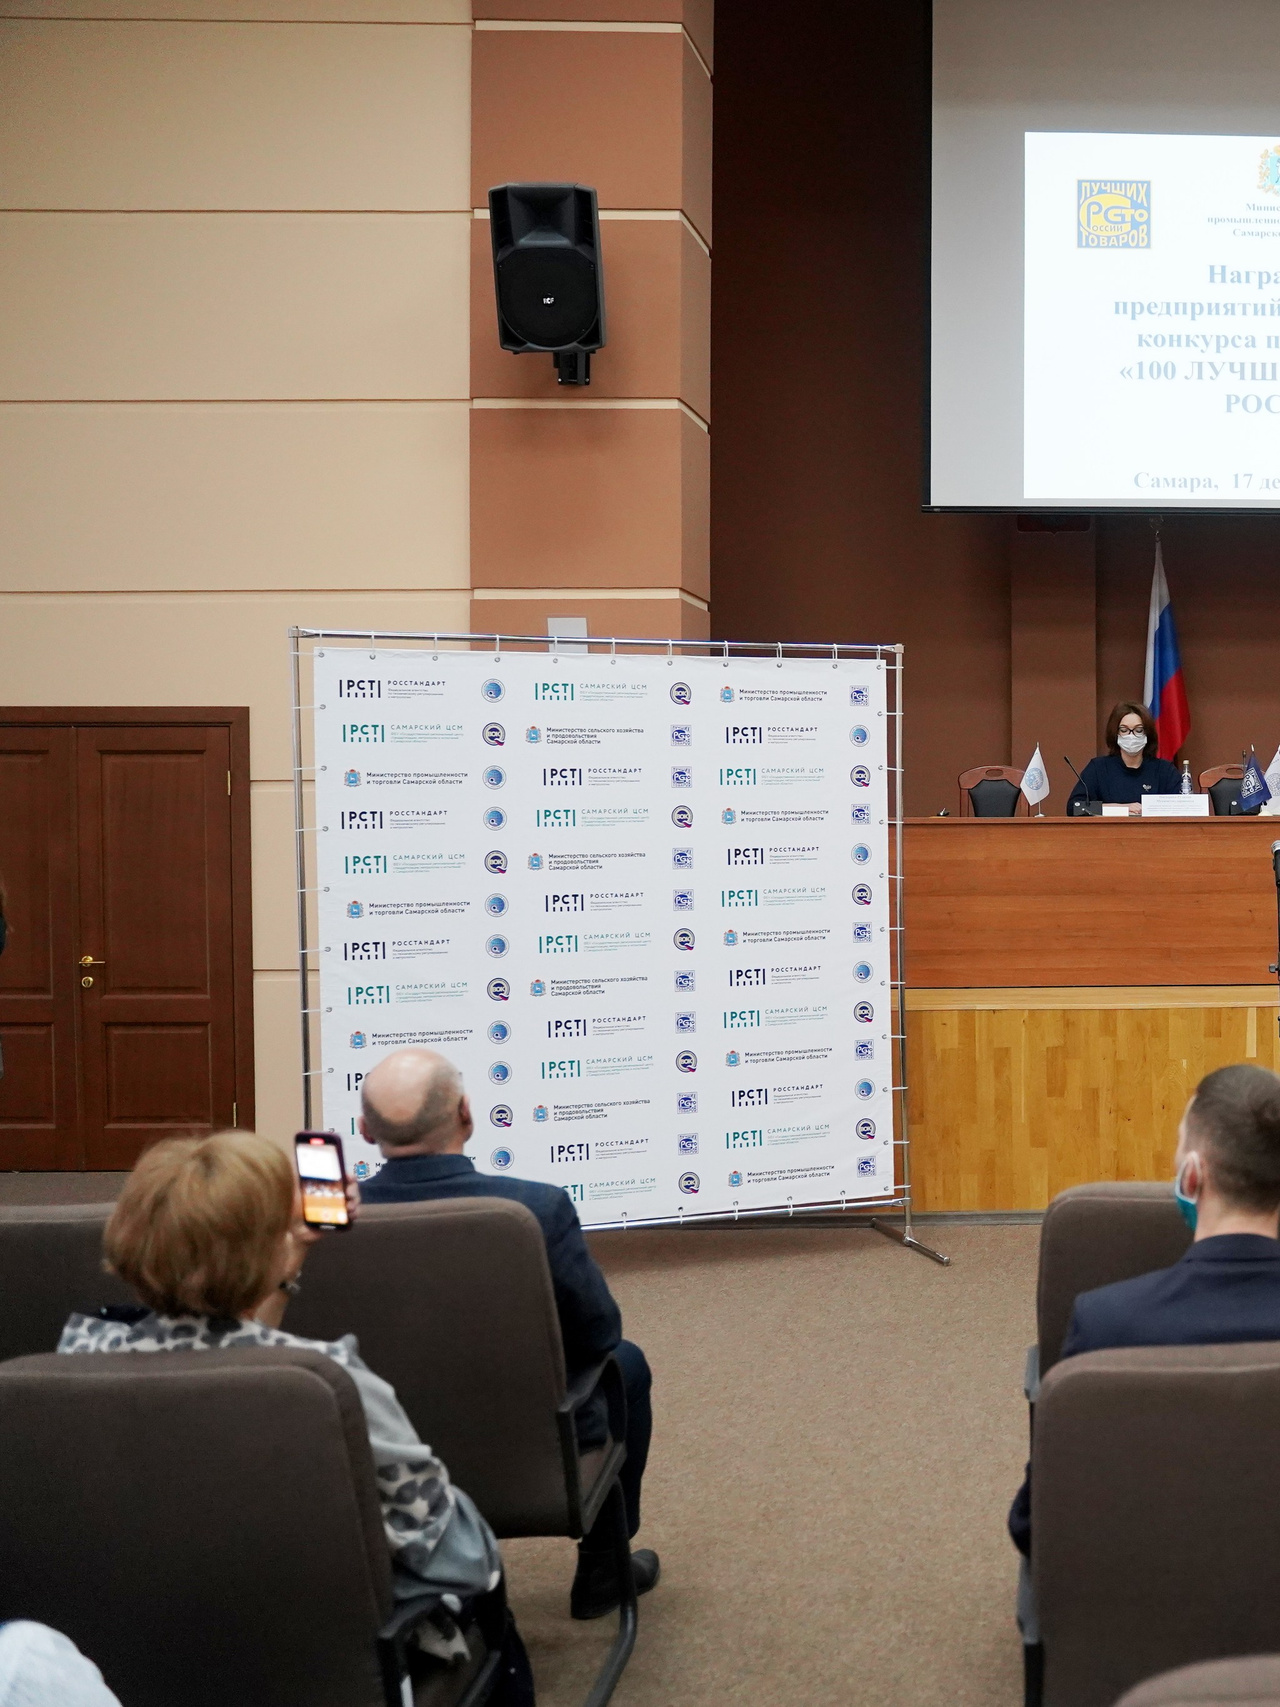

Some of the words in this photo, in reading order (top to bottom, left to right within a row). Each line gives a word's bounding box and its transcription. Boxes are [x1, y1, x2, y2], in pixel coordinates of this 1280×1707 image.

[1137, 333, 1257, 354] конкурса
[1119, 360, 1177, 380] «100
[1133, 472, 1219, 493] Самара,
[1231, 473, 1253, 489] 17
[586, 1056, 632, 1064] САМАРСКИЙ
[773, 1084, 823, 1092] РОССТАНДАРТ
[768, 1125, 810, 1134] САМАРСКИЙ
[595, 1139, 648, 1147] РОССТАНДАРТ
[787, 1166, 834, 1174] промышленности
[589, 1179, 635, 1188] САМАРСКИЙ
